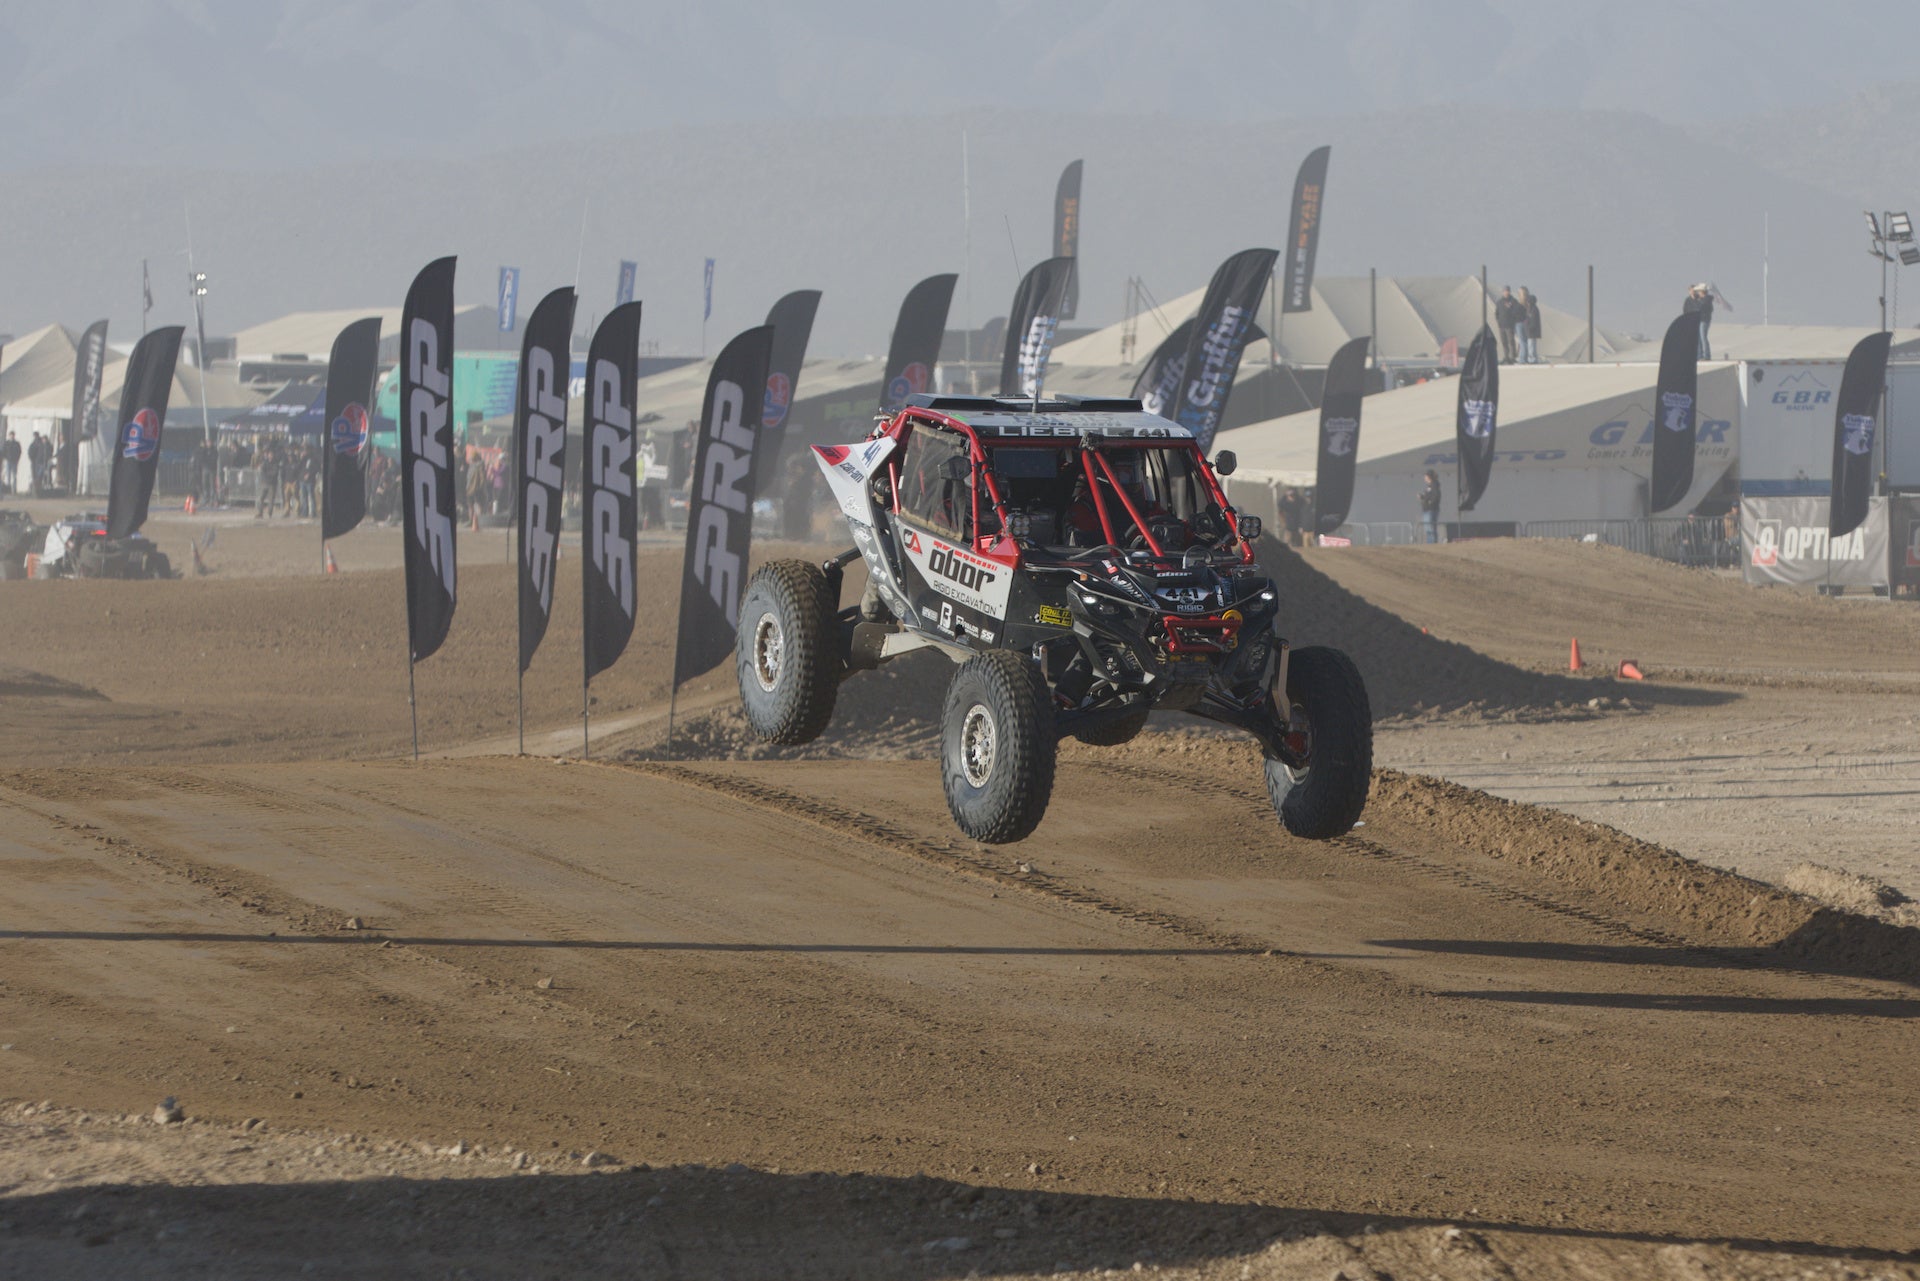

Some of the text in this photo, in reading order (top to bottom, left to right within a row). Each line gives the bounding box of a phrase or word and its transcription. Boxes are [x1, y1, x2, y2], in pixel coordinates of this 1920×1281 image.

[1186, 303, 1244, 408] Griffin
[1771, 390, 1832, 404] GBR
[1137, 428, 1171, 438] 441
[950, 586, 998, 617] EXCAVATION
